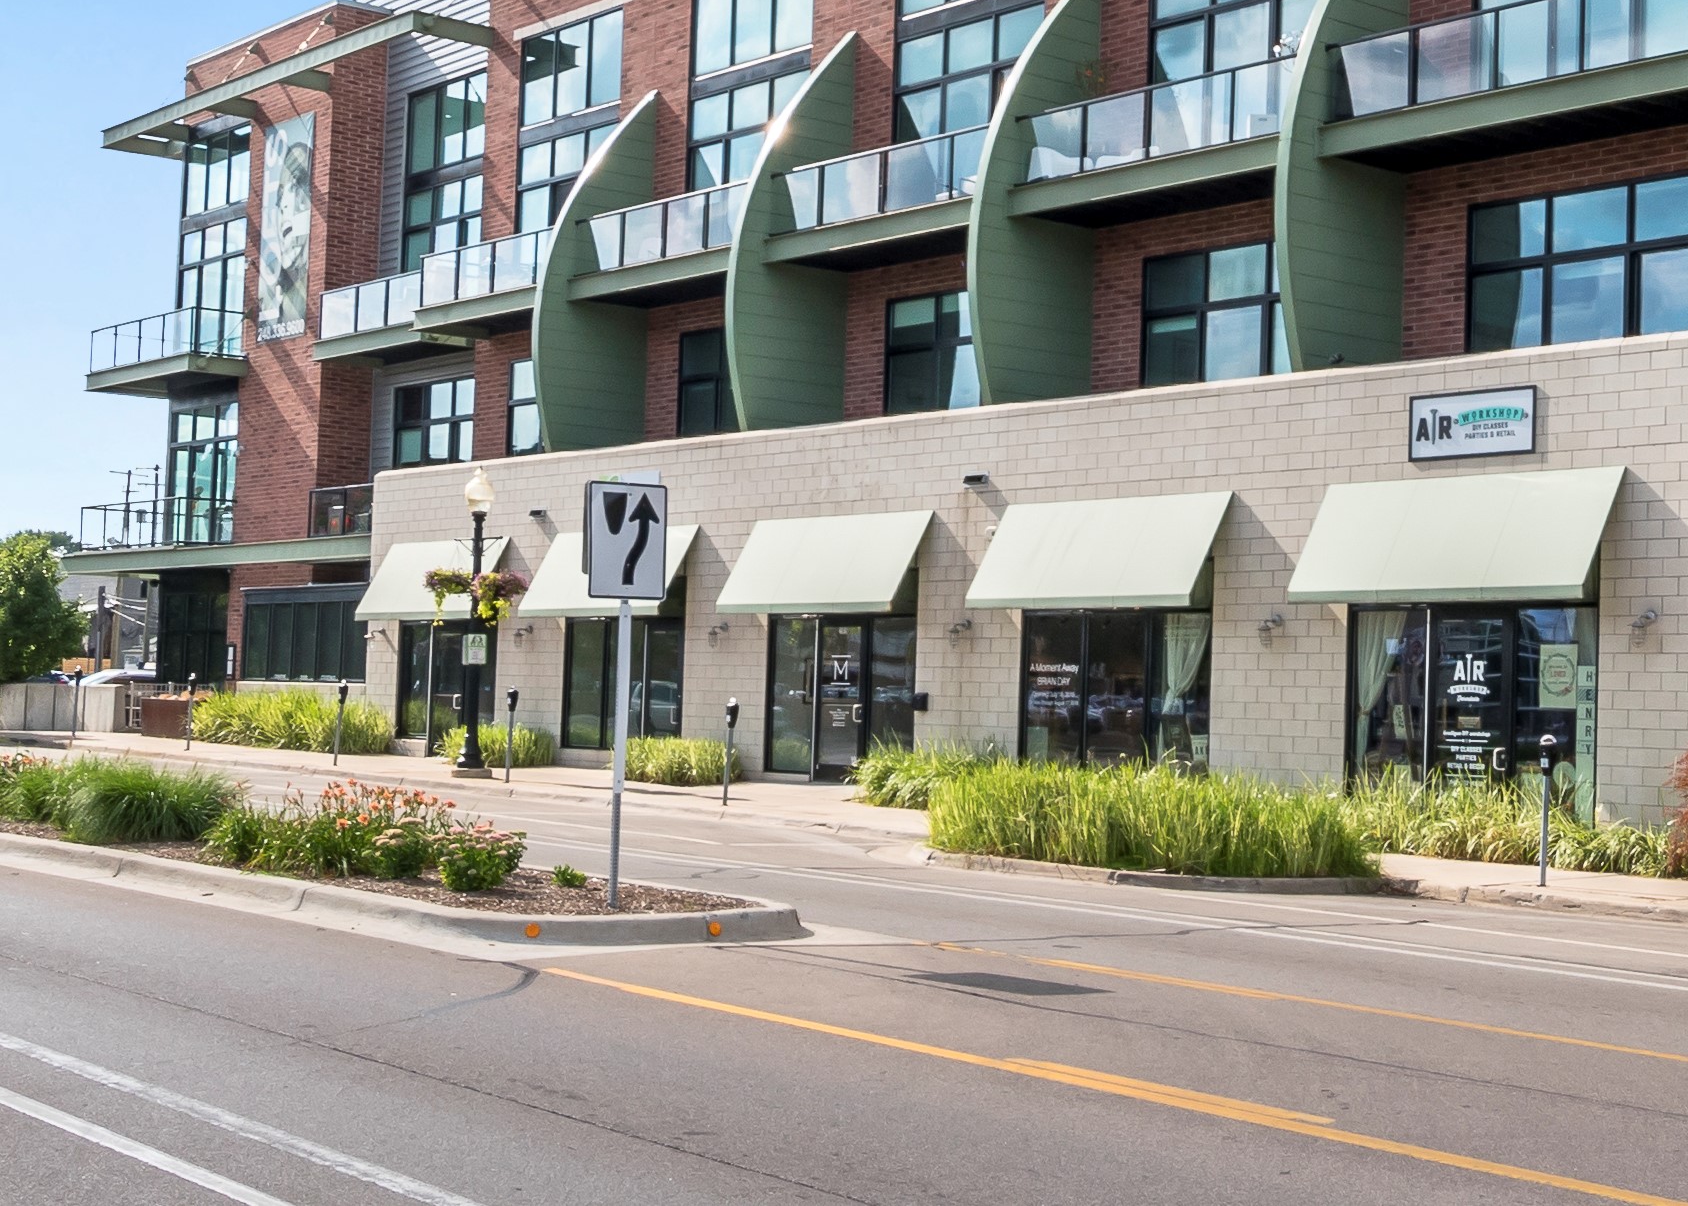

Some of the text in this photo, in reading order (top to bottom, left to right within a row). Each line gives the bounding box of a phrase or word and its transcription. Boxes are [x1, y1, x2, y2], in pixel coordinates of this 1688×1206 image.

[1461, 408, 1519, 423] WORKSHOP
[1483, 422, 1508, 430] CLASSES
[1464, 431, 1489, 440] PARTIES
[833, 660, 848, 681] M
